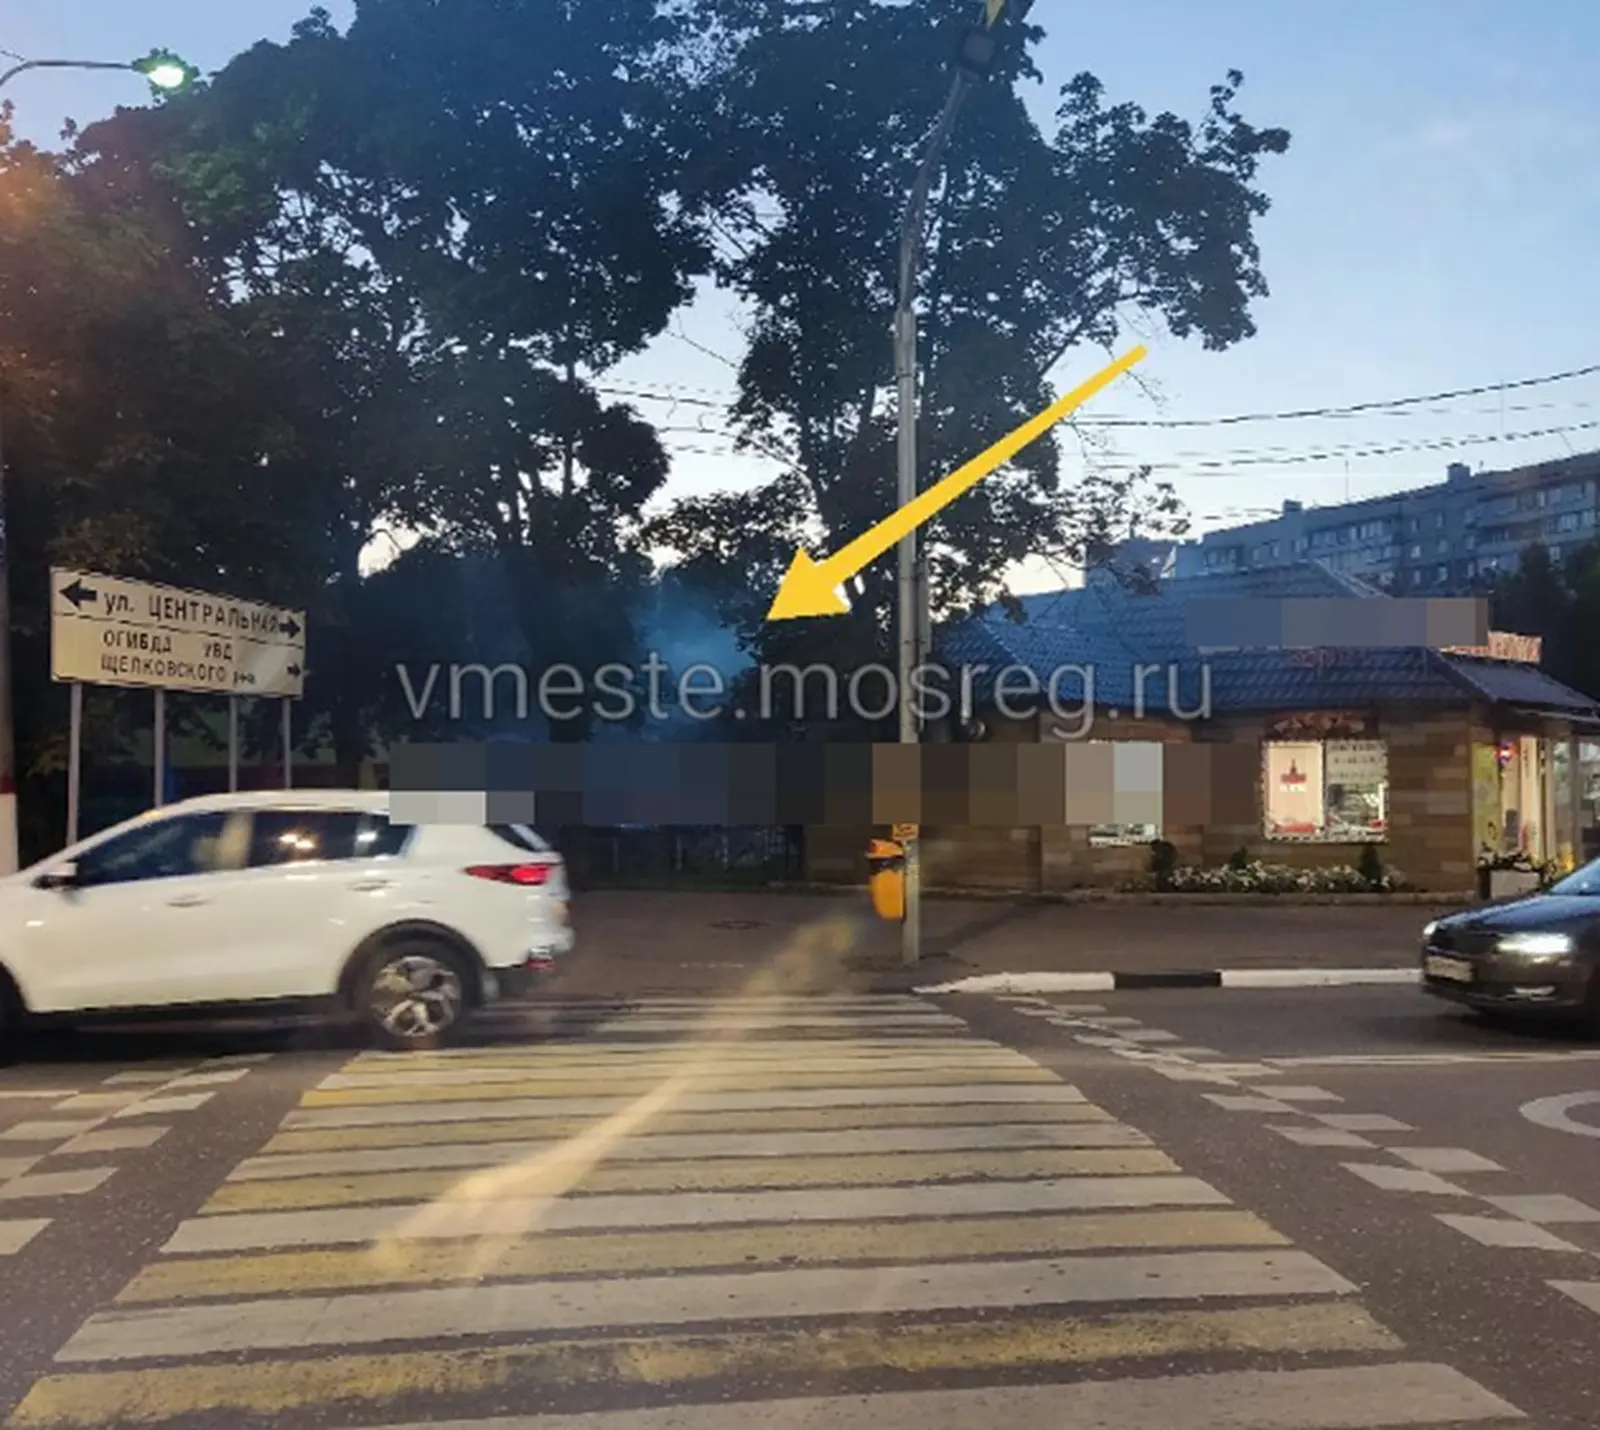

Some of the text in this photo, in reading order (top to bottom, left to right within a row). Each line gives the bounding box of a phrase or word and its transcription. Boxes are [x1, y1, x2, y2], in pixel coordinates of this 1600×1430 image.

[104, 592, 278, 633] ул. ЦЕНТРАЛЬНАЯ
[101, 653, 226, 682] ЩЕЛКОВСКОГО
